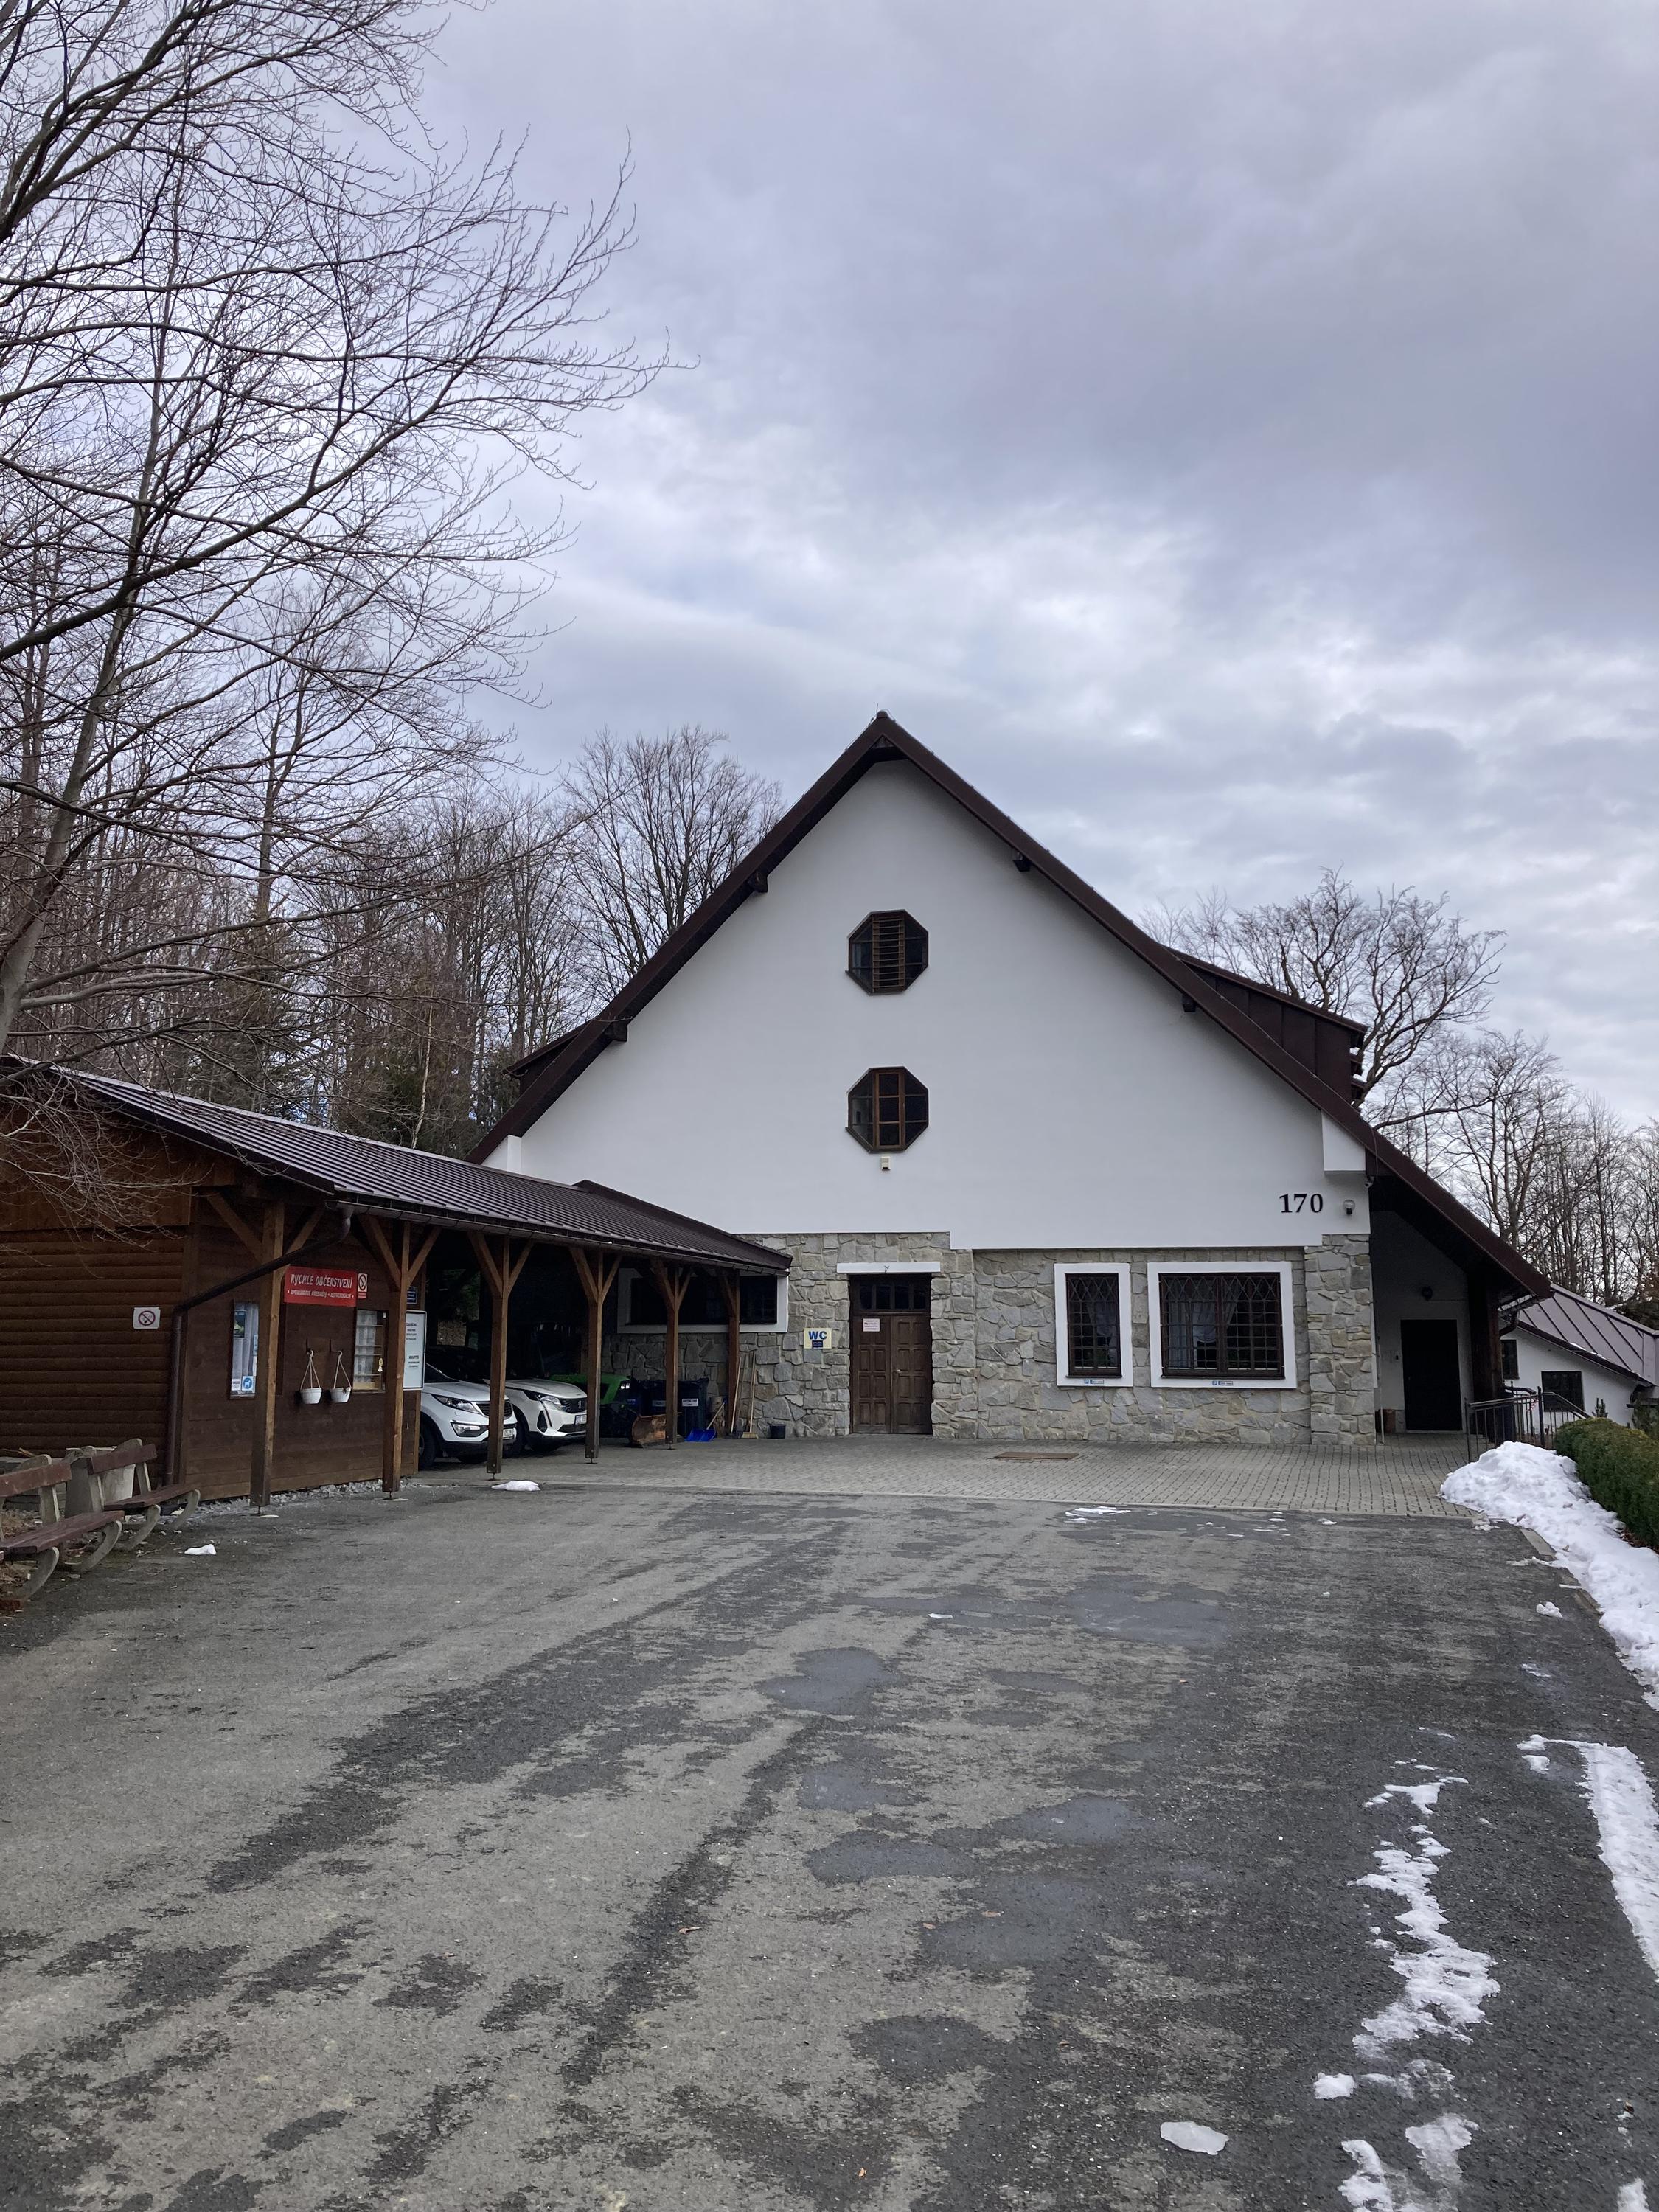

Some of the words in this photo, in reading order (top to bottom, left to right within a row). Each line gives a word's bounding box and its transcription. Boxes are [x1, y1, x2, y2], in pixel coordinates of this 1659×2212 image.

[1279, 1193, 1323, 1213] 170
[290, 1273, 314, 1286] RYCHLÉ
[315, 1275, 352, 1289] OBČERSTVENÍ
[808, 1331, 827, 1340] WC
